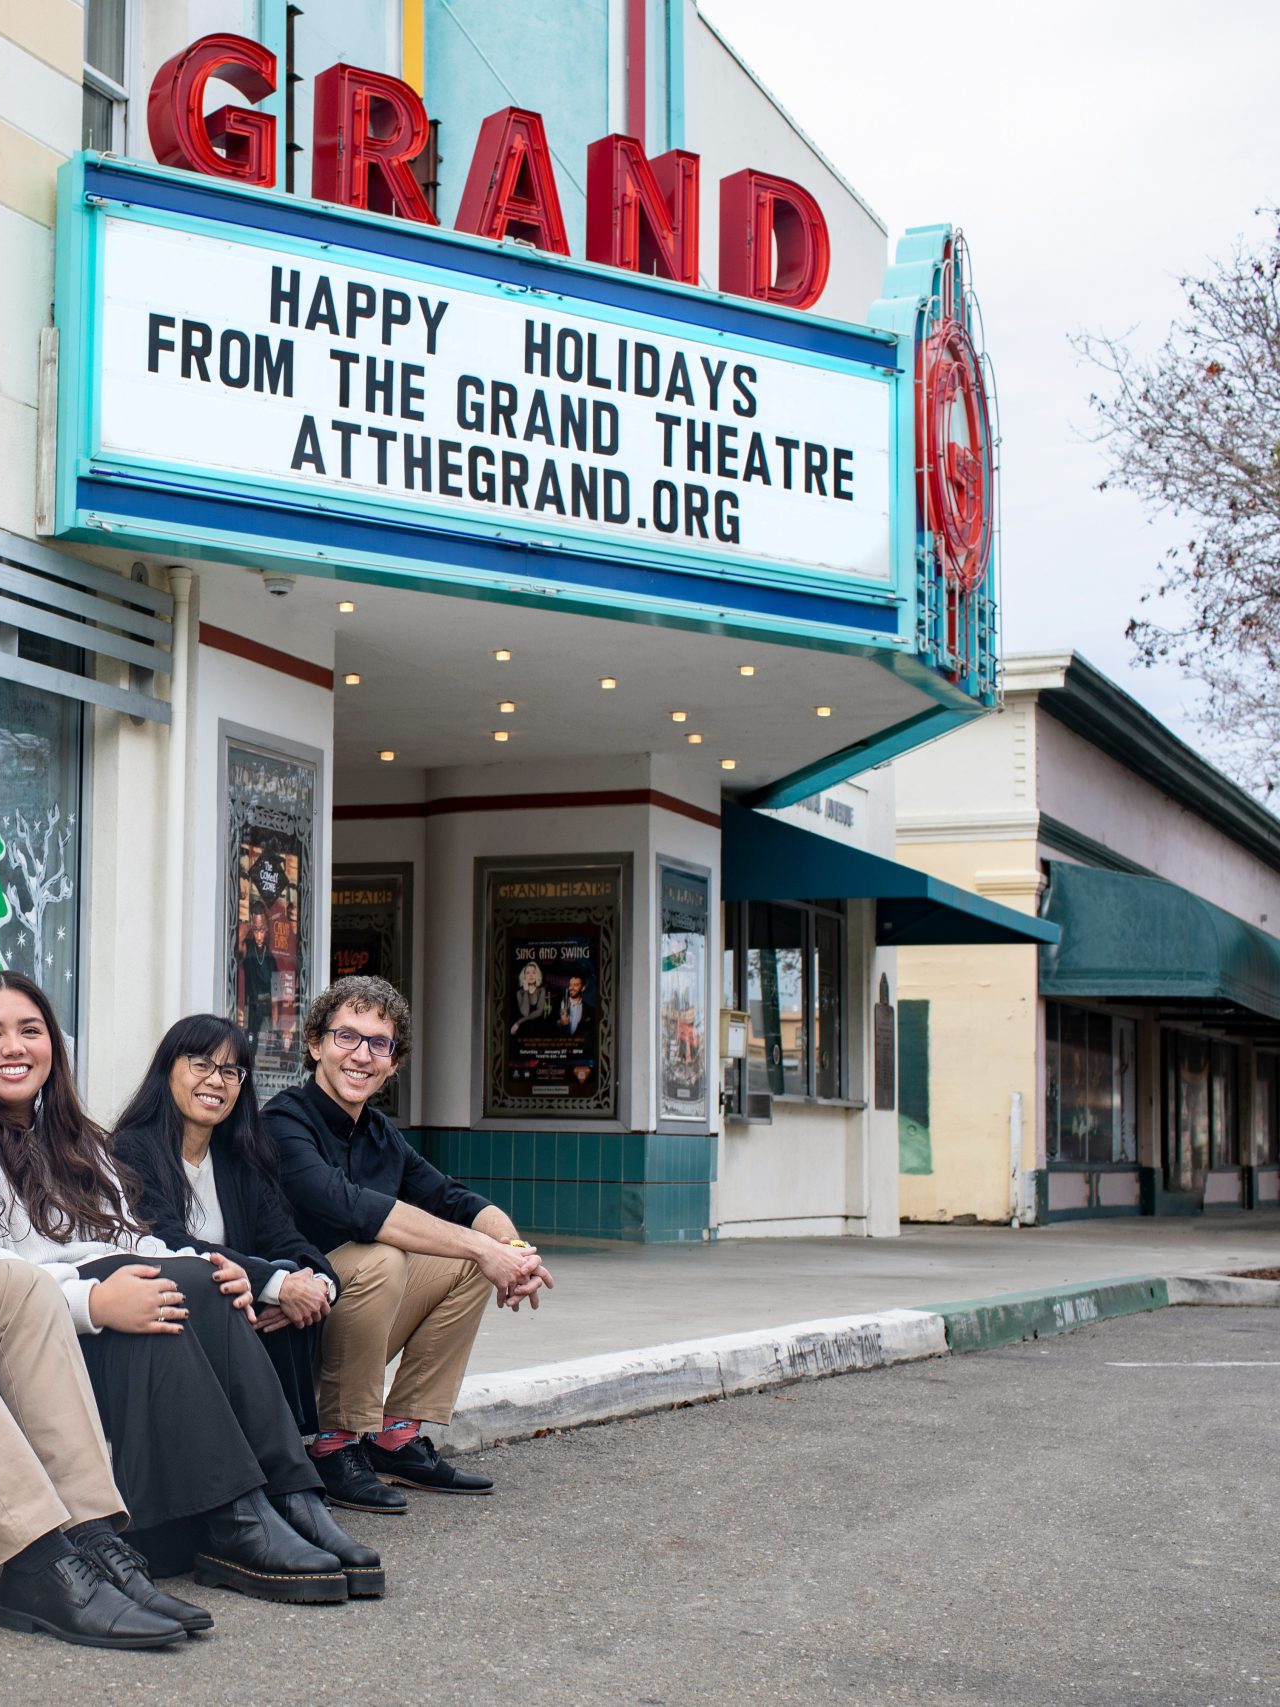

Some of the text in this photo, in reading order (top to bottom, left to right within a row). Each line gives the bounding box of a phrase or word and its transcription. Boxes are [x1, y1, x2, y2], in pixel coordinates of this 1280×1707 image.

[147, 33, 830, 309] GRAND
[146, 312, 855, 502] FROM THE GRAND THEATRE
[269, 266, 758, 419] HAPPY HOLIDAYS
[290, 415, 741, 545] ATTHEGRAND.ORG
[335, 890, 393, 905] THEATRE
[498, 880, 612, 898] GRAND THEATRE
[515, 946, 590, 960] SING AND SWING
